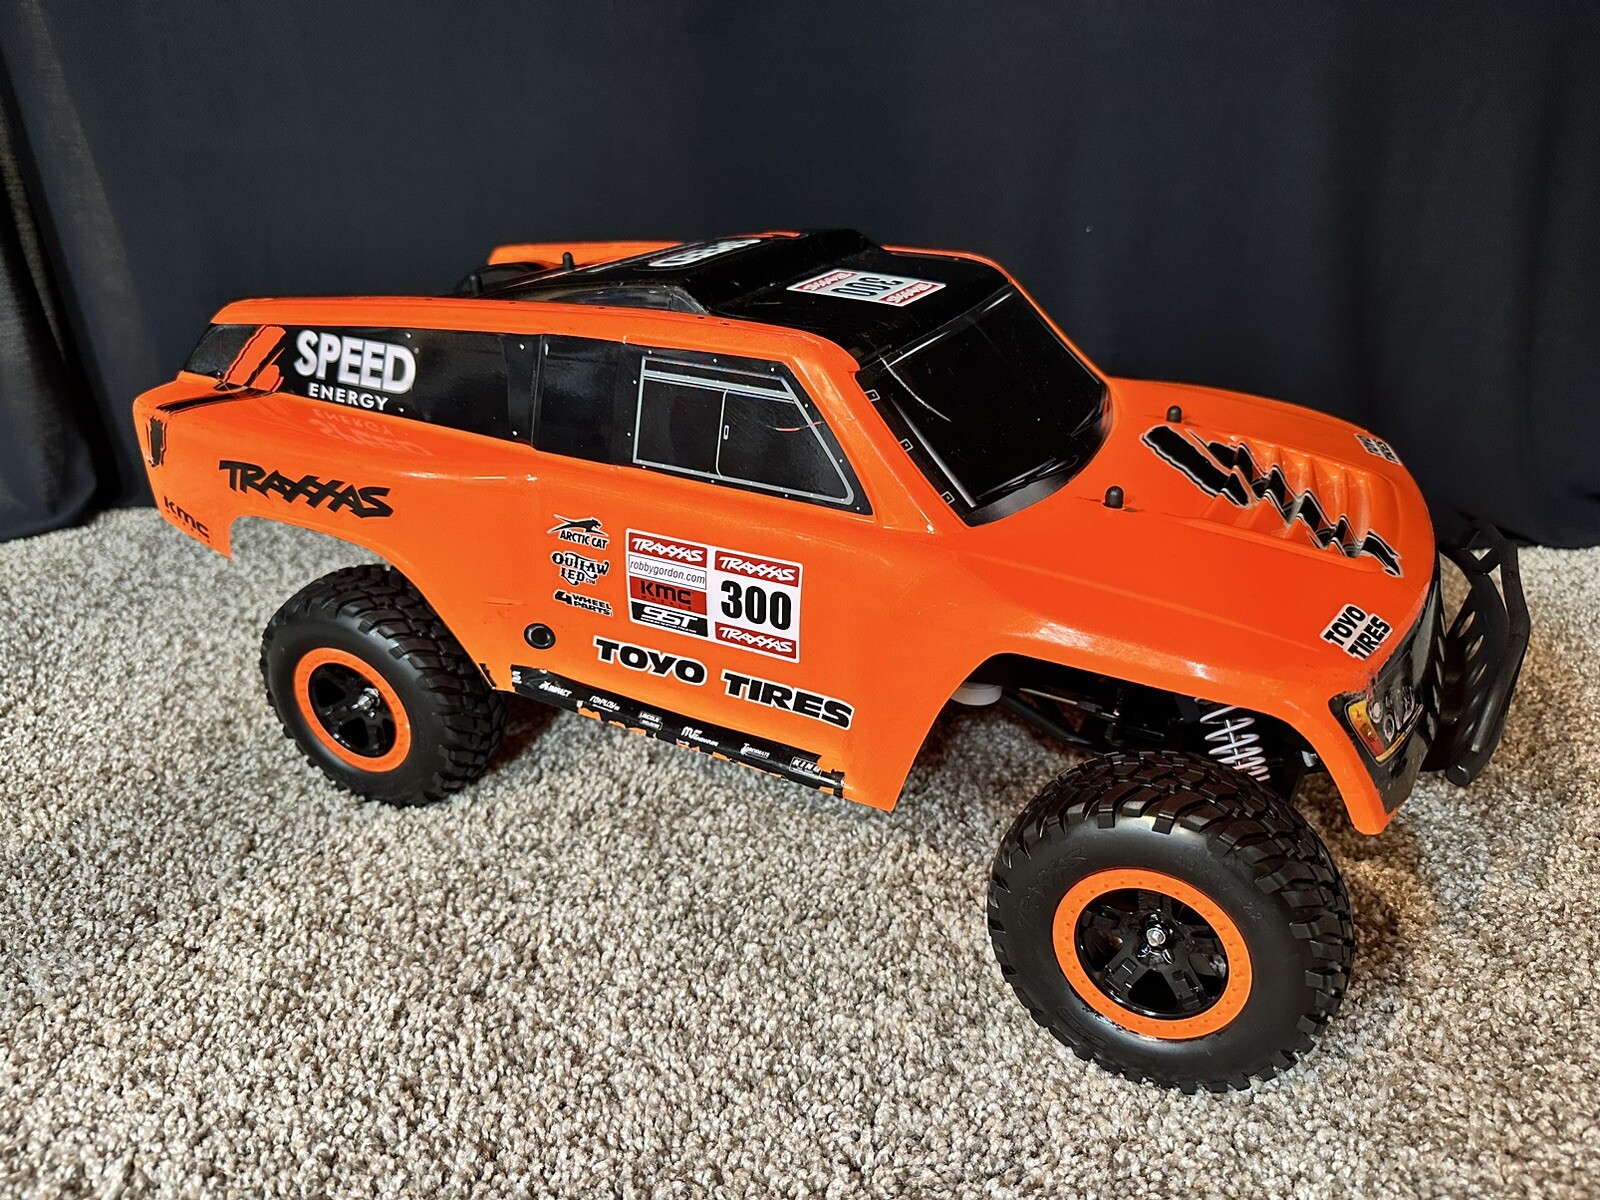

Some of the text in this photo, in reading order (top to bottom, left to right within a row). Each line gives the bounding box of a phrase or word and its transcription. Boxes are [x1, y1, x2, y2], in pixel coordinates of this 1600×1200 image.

[830, 276, 904, 297] 300
[294, 328, 417, 395] SPEED
[308, 383, 389, 411] ENERGY
[219, 460, 394, 518] TRAXXAS
[560, 530, 608, 549] ARCTIC CAT
[631, 537, 704, 562] TRAXXAS
[552, 552, 610, 579] OUTLAW
[630, 559, 706, 585] robbygordon.com
[718, 557, 796, 582] TRAXXAS
[554, 591, 611, 609] 4 WHEEL
[574, 601, 612, 615] PARTS
[720, 580, 792, 631] 300
[1323, 605, 1367, 646] TOYO
[1347, 615, 1391, 660] TIRES
[718, 626, 793, 652] TRAXXAS
[595, 638, 853, 729] TOYO TIRES
